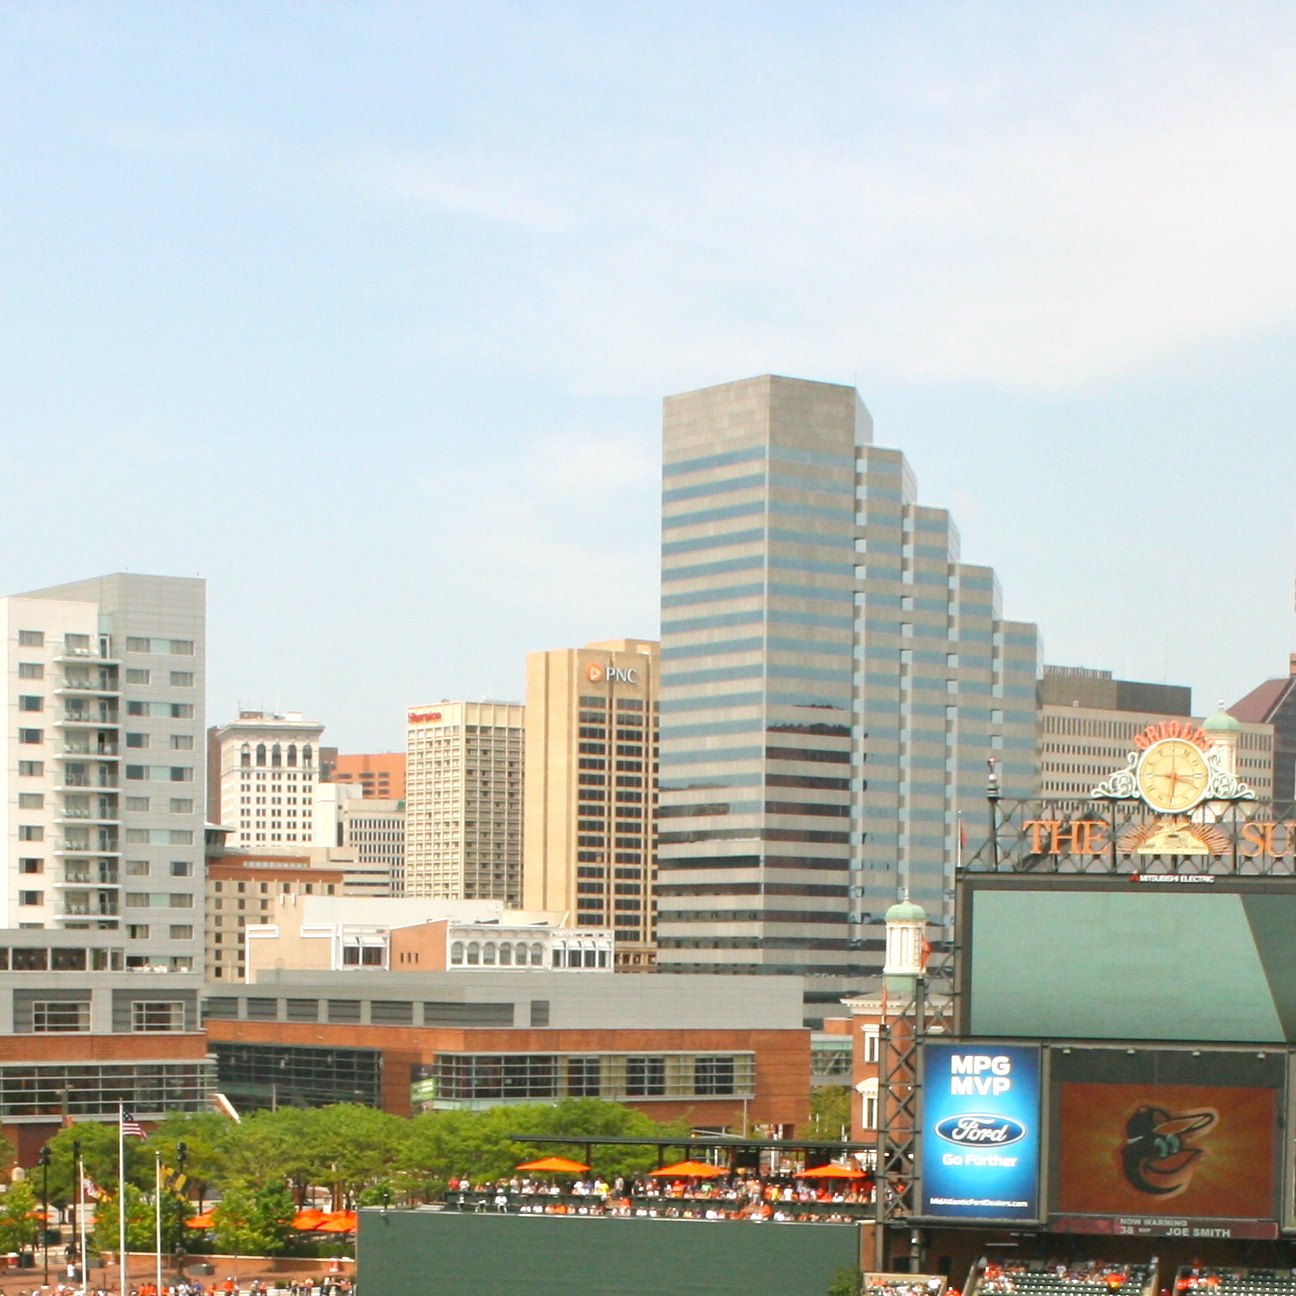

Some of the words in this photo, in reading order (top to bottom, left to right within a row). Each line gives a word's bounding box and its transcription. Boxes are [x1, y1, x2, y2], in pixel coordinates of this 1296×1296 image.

[605, 666, 638, 684] PNC
[1134, 719, 1216, 750] ORIOLES
[1023, 819, 1111, 855] THE
[1180, 874, 1215, 884] ELECTRIC
[950, 1055, 1012, 1076] MPG
[950, 1076, 1012, 1096] MVP
[951, 1117, 1009, 1142] Ford
[942, 1153, 963, 1167] Go
[965, 1154, 1018, 1168] Further
[1166, 1227, 1189, 1237] JOE
[1192, 1228, 1231, 1238] SMITH
